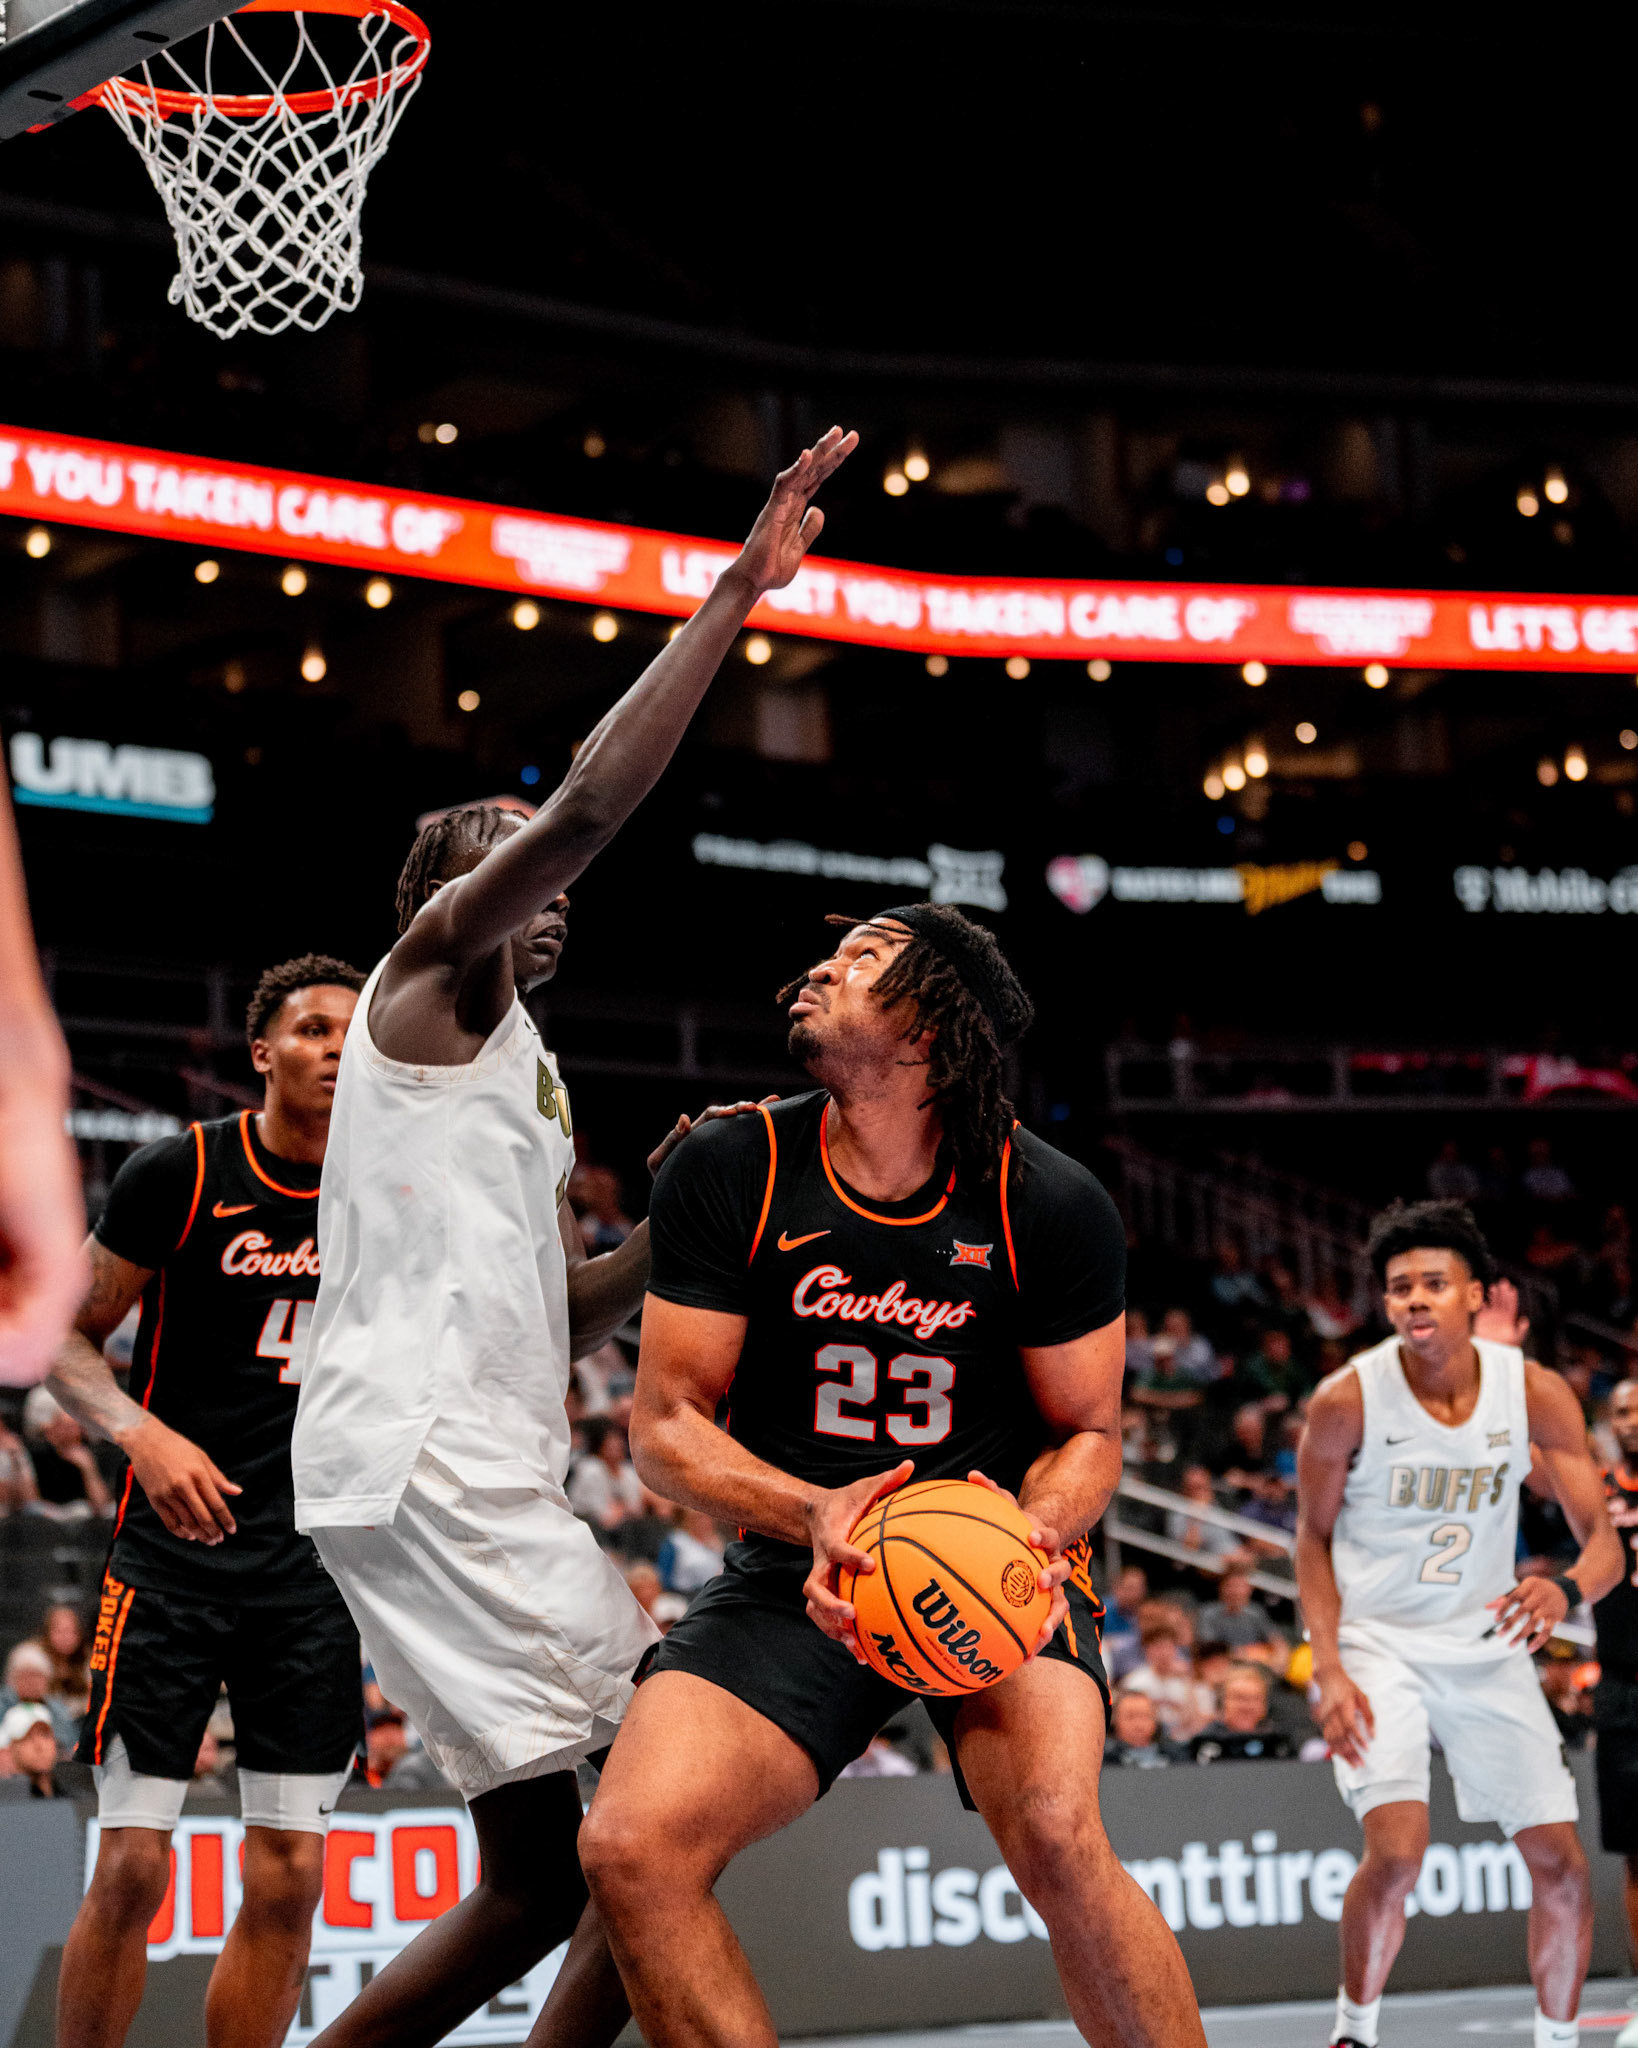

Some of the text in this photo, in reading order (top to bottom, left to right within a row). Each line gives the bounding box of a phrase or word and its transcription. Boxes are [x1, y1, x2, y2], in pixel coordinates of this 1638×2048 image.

[26, 444, 124, 507] YOU
[127, 461, 275, 532] TAKEN
[277, 486, 389, 550] CARE
[841, 577, 923, 630] YOU
[925, 586, 1065, 638] TAKEN
[1068, 592, 1182, 642] CARE
[1581, 605, 1638, 655] GE
[10, 732, 215, 808] UMB
[221, 1229, 320, 1276] Cowbo
[791, 1264, 977, 1340] Cowboys
[256, 1299, 316, 1385] 4
[814, 1343, 956, 1446] 23
[1387, 1463, 1510, 1513] BUFFS
[1418, 1523, 1473, 1585] 2
[90, 1576, 124, 1671] POKES
[912, 1578, 1004, 1684] Wilson
[848, 1829, 1533, 1952] discnttireom
